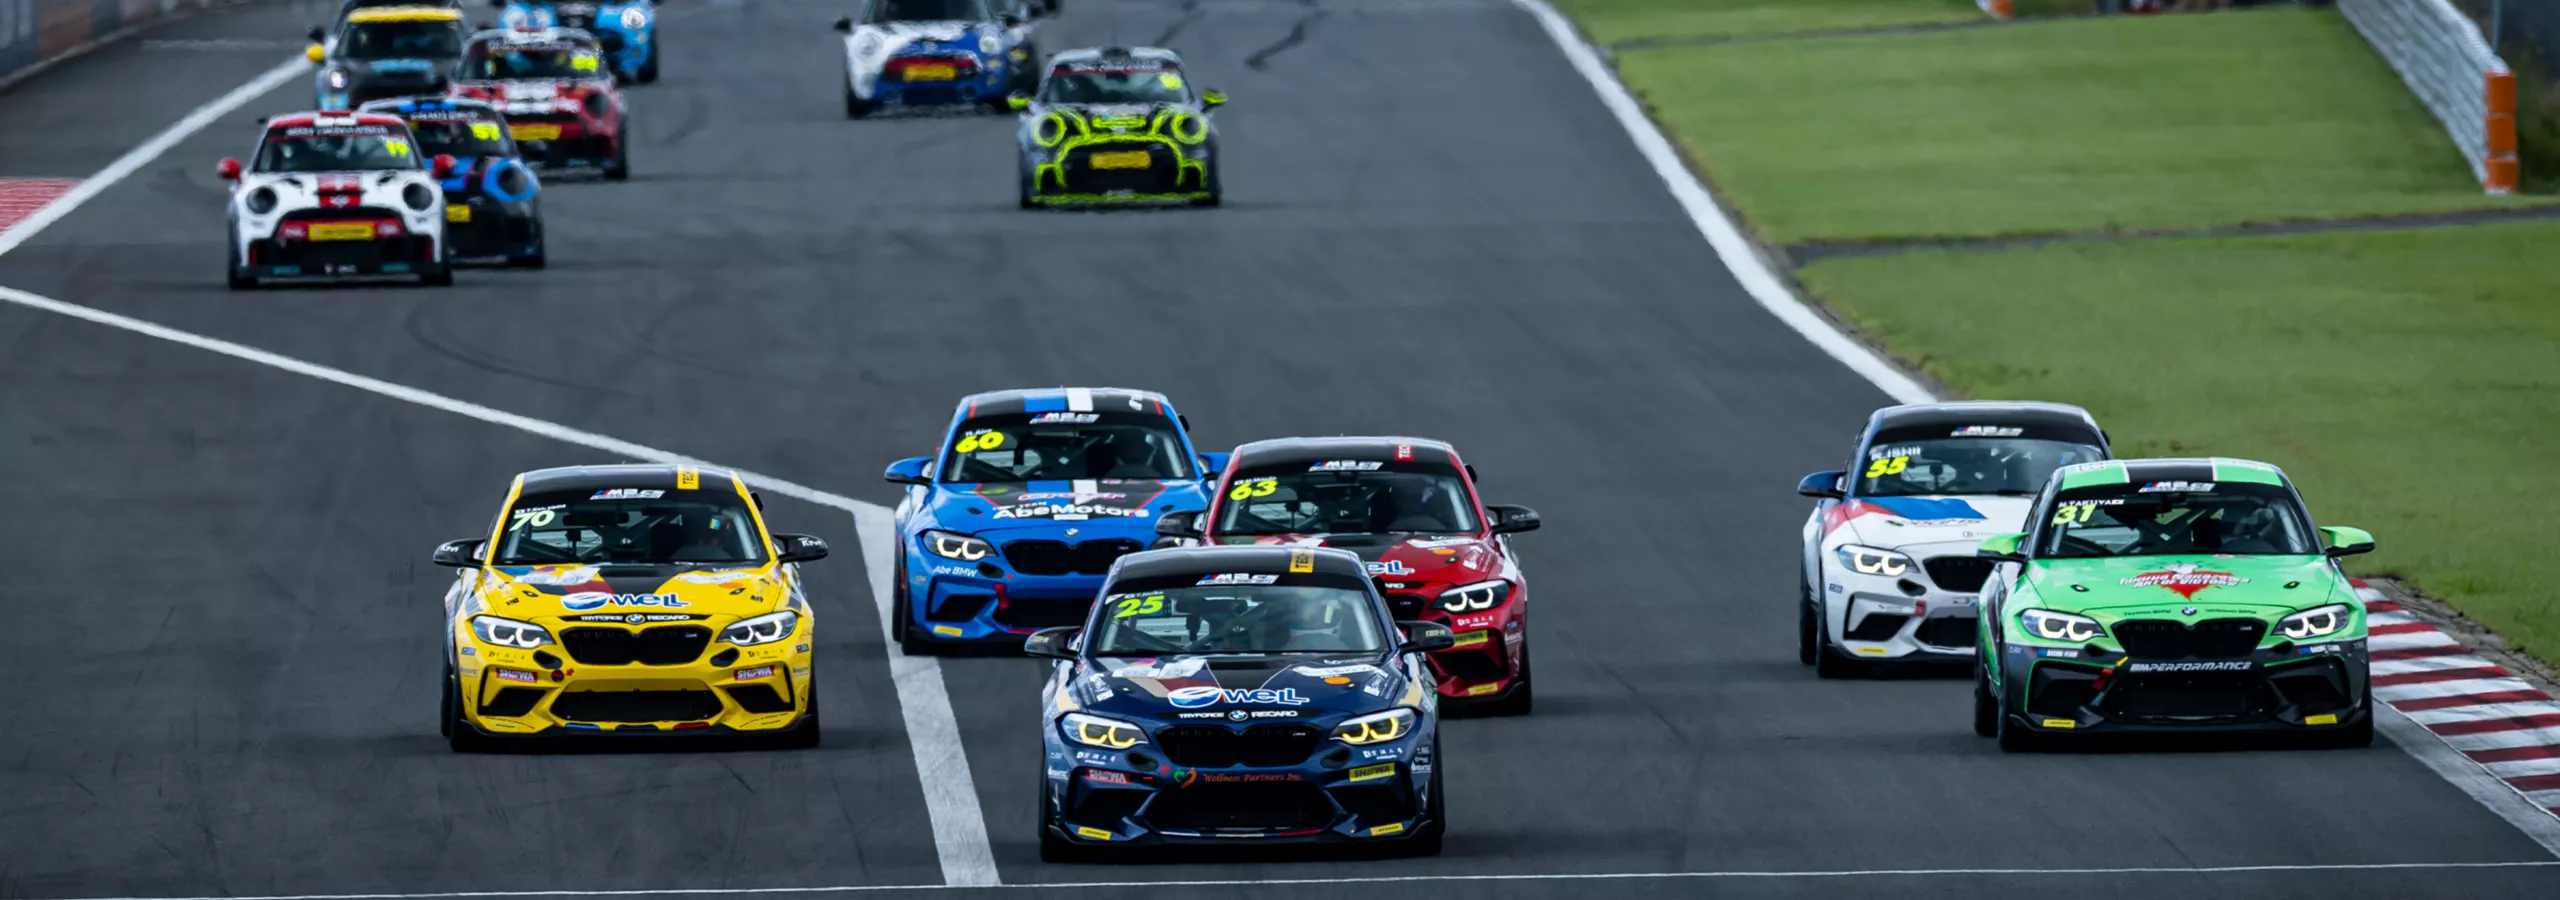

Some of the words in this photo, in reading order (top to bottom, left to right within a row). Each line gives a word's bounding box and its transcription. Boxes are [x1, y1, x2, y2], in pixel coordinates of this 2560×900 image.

[955, 431, 1005, 453] 60
[1865, 456, 1910, 478] 55
[1229, 480, 1278, 501] 63
[509, 510, 556, 532] 70
[2054, 504, 2096, 525] 31
[933, 565, 950, 575] Abe
[952, 566, 977, 577] BMW
[1114, 595, 1164, 618] 25
